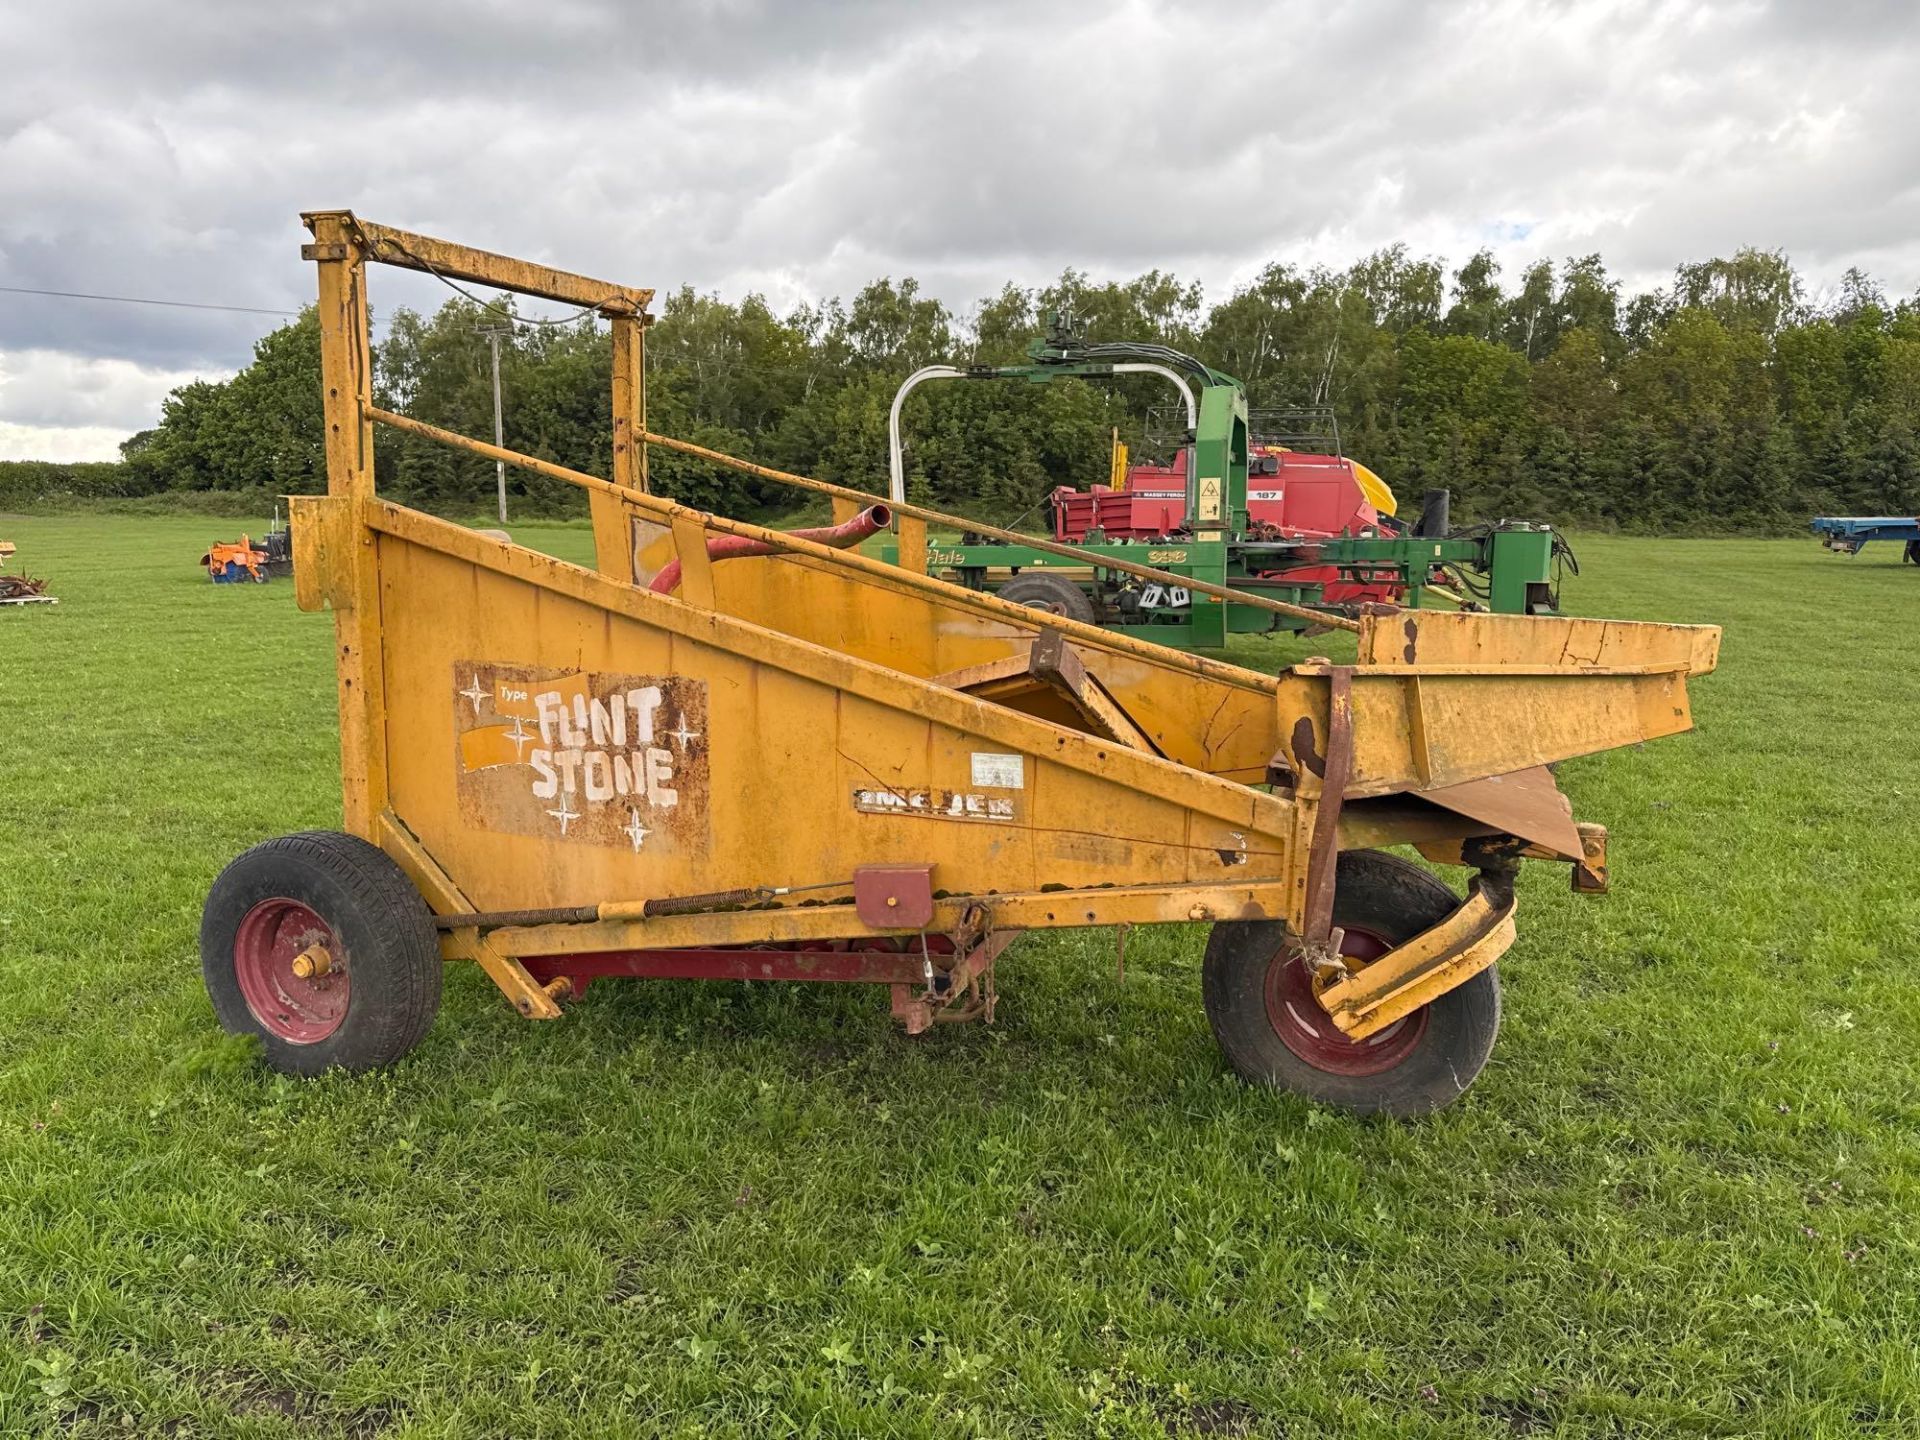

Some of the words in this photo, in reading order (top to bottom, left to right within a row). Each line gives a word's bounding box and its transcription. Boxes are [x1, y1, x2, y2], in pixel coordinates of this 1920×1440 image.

[927, 549, 966, 565] Hale
[500, 686, 528, 703] Type
[534, 685, 662, 747] FLINT
[529, 747, 679, 808] STONE
